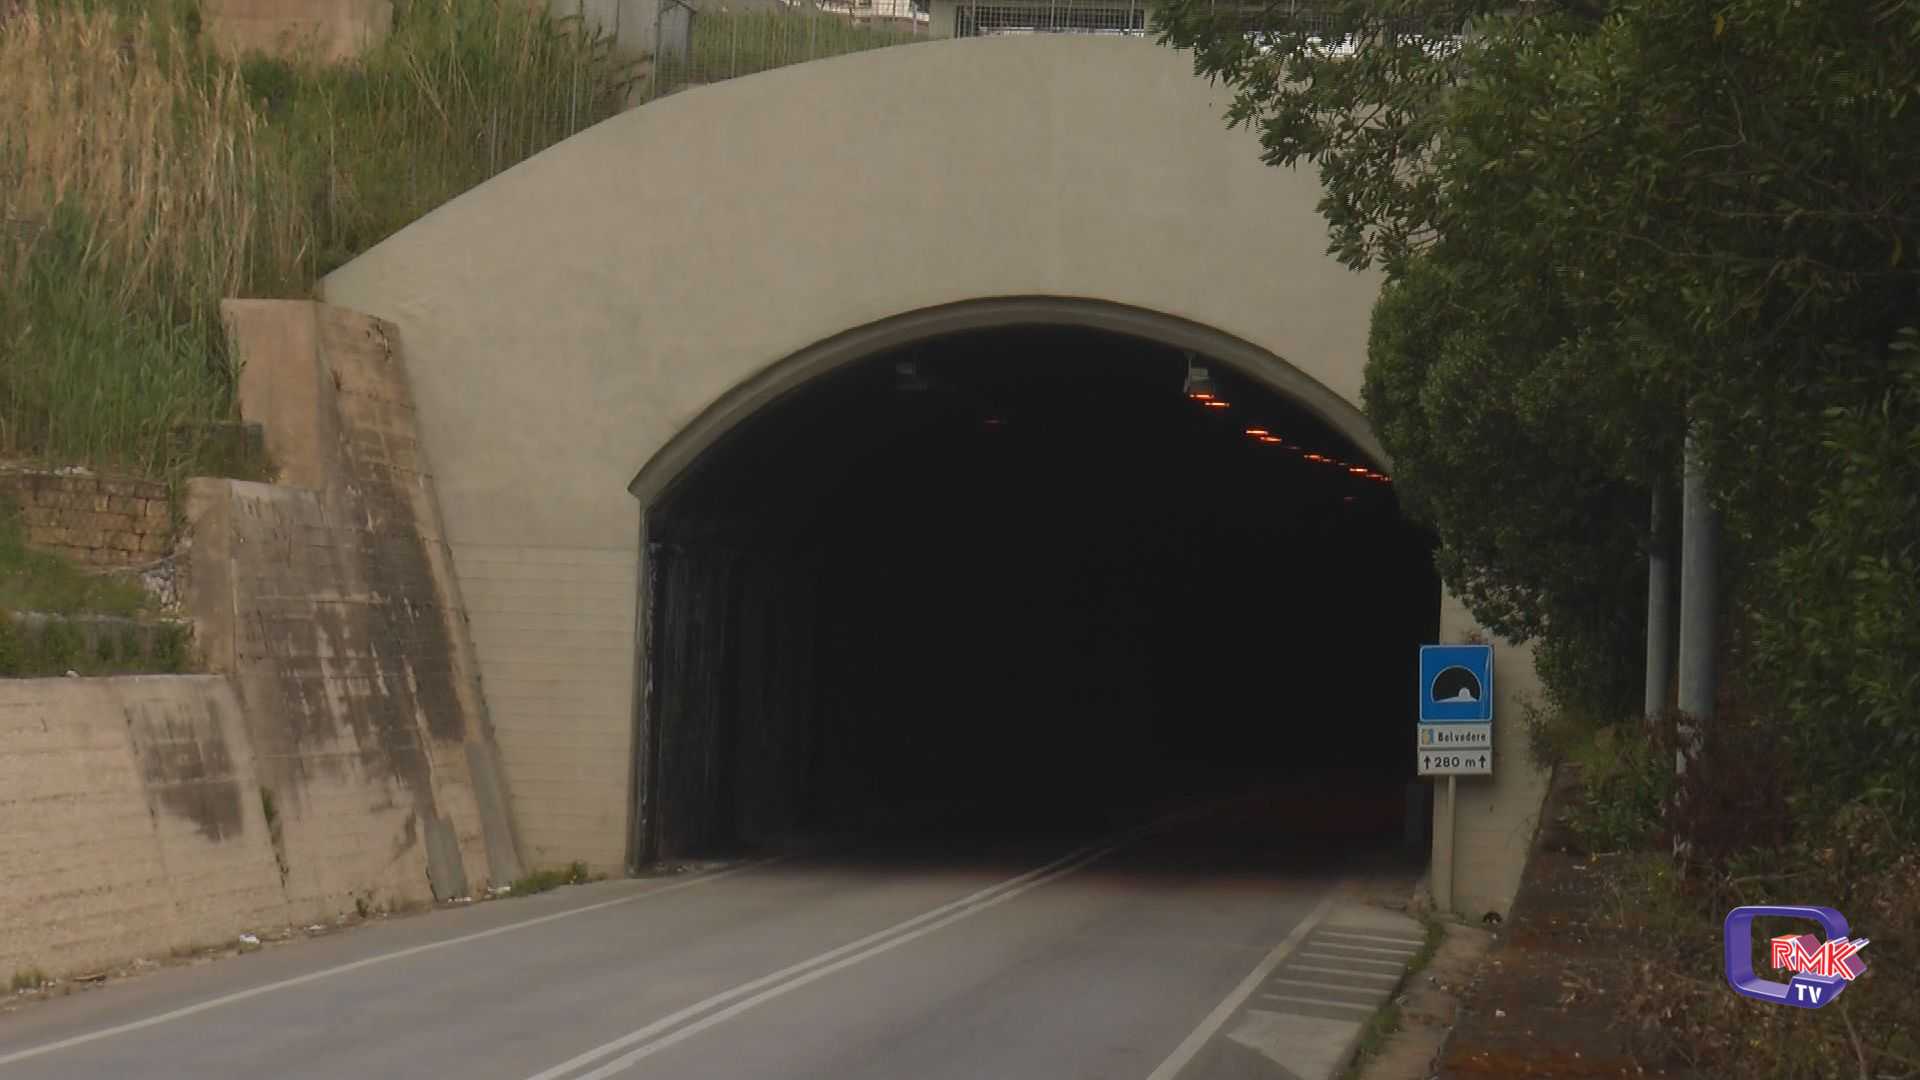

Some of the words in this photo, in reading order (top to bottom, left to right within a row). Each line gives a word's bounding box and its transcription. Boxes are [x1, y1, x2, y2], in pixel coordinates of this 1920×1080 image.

[1438, 731, 1487, 742] Belvedere
[1434, 756, 1460, 768] 280
[1465, 758, 1476, 768] m
